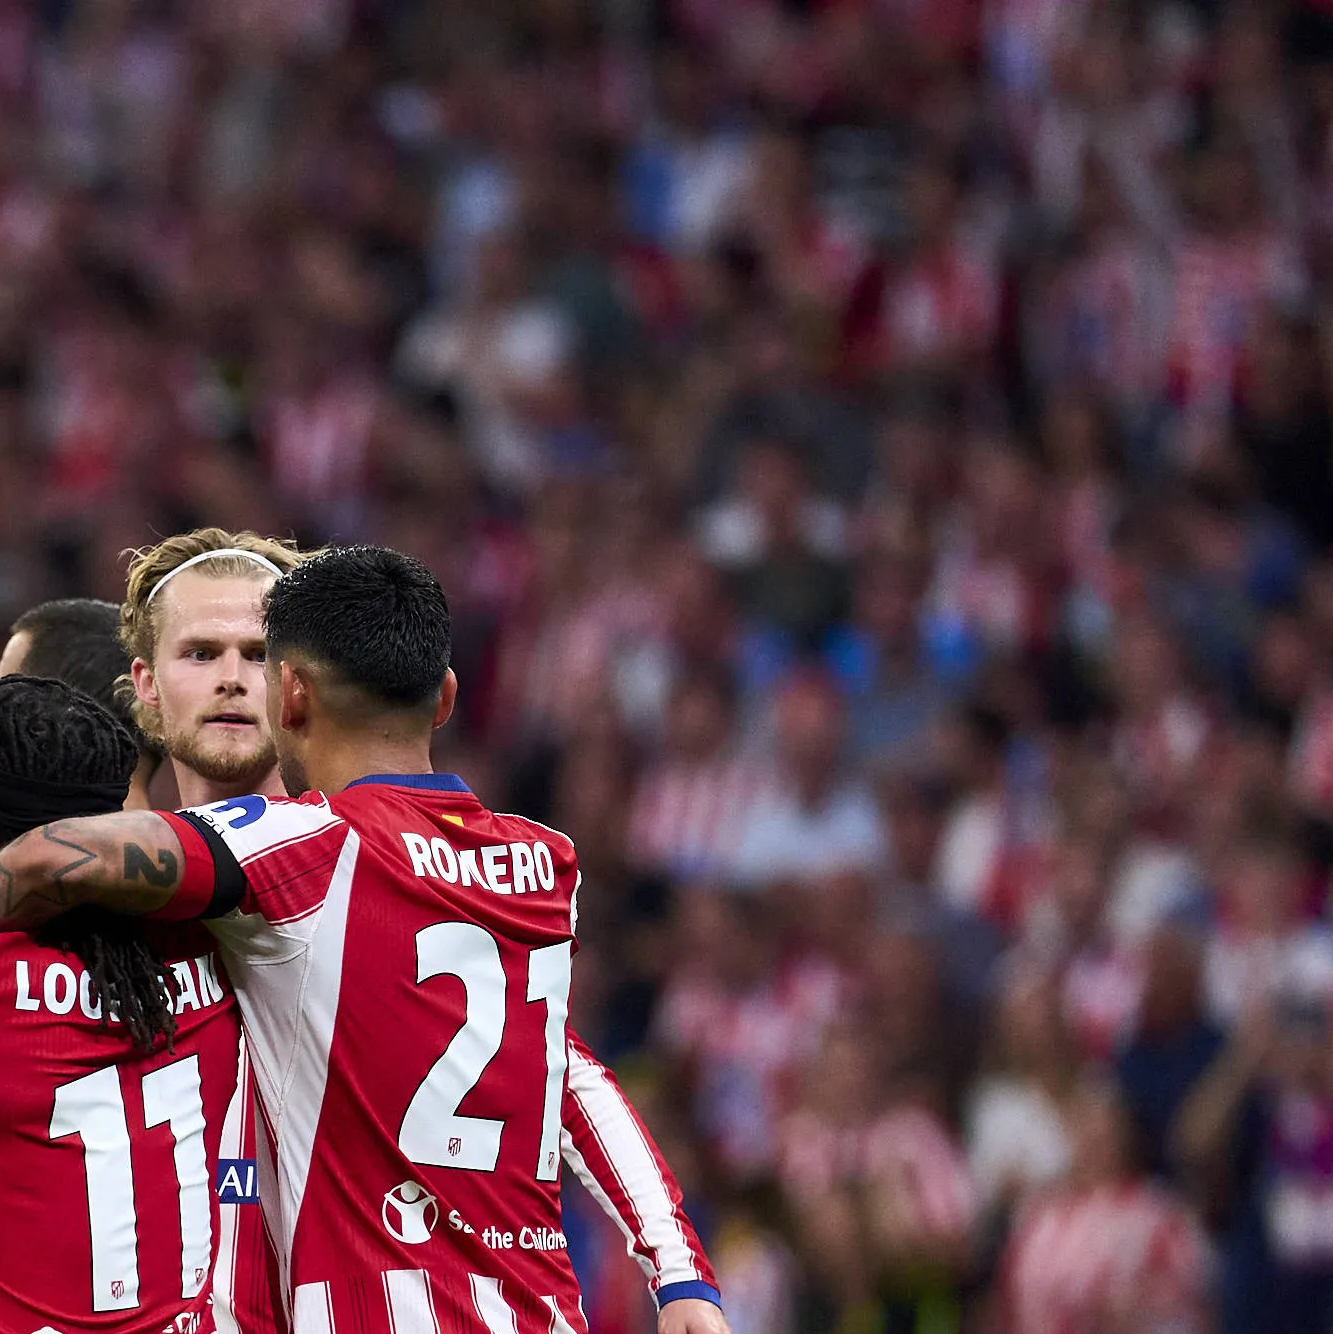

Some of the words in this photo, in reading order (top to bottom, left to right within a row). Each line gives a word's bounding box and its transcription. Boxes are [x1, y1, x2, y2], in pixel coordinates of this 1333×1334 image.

[400, 832, 555, 895] ROMERO
[398, 921, 573, 1182] 21
[49, 1053, 215, 1314] 11
[481, 1225, 513, 1249] the
